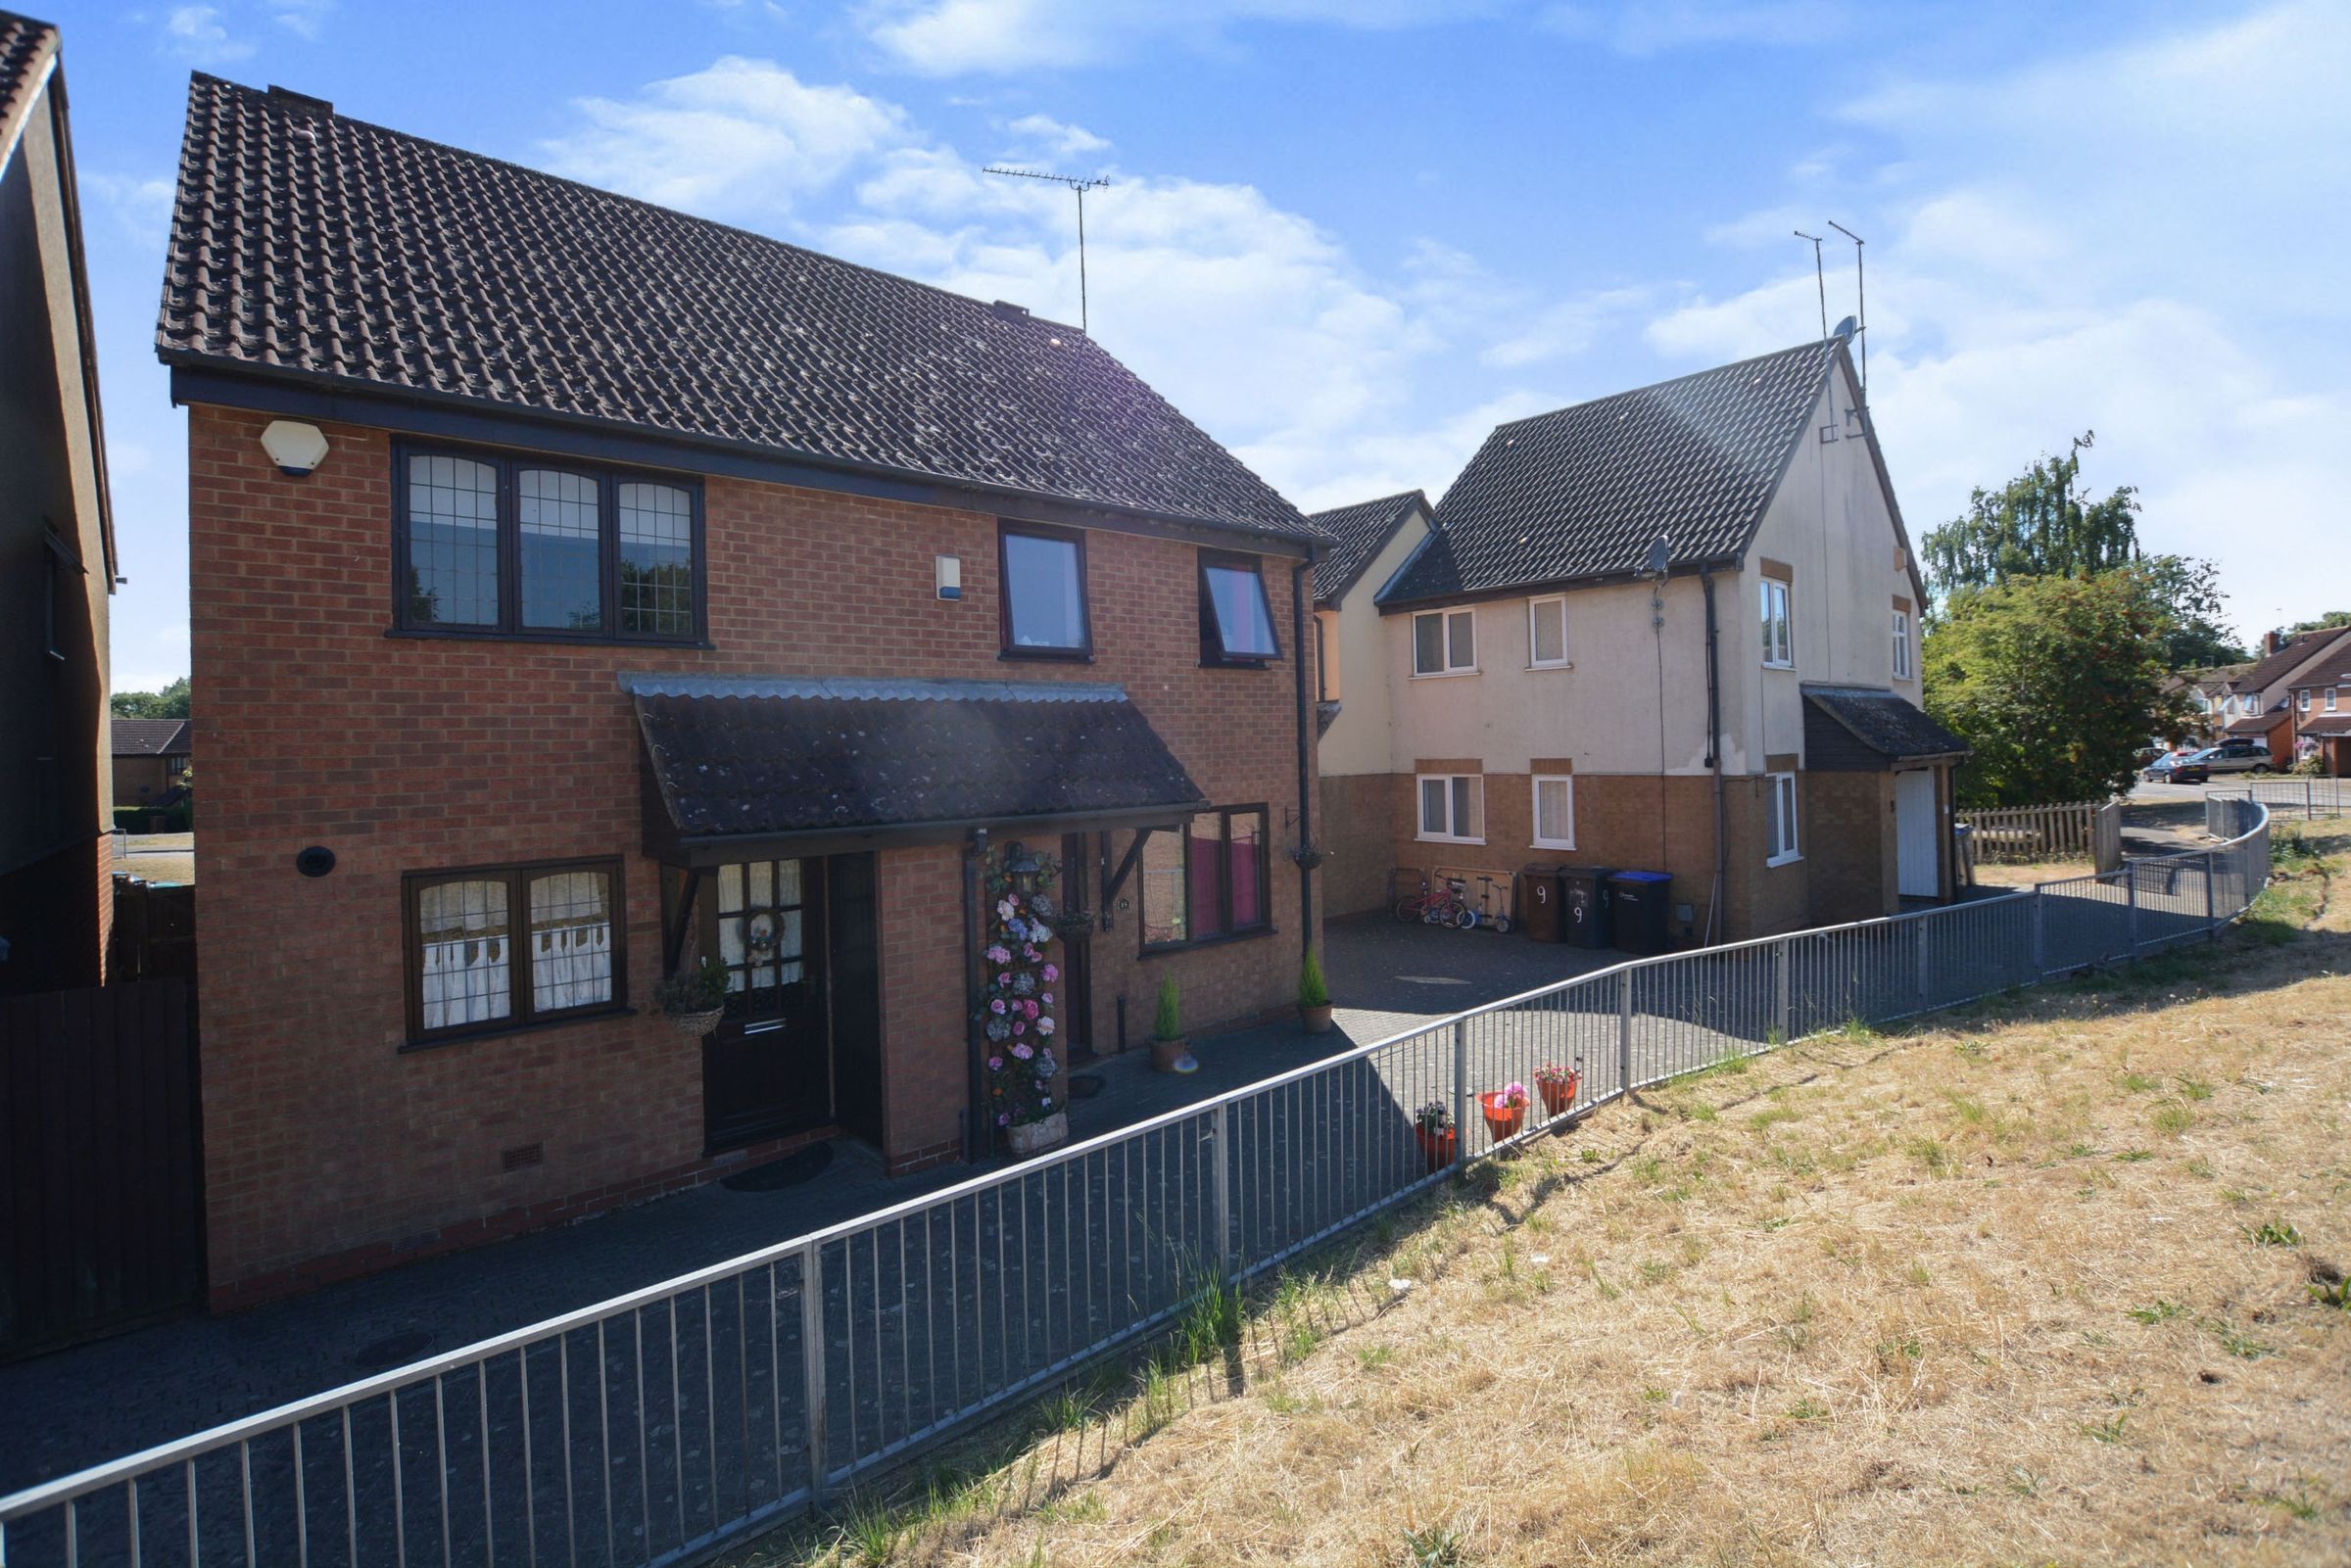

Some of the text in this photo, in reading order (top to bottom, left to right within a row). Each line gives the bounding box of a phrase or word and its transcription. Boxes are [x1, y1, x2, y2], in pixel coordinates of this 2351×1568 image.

[1536, 885, 1546, 904] 9
[1603, 889, 1609, 909] 9
[1574, 906, 1583, 924] 9
